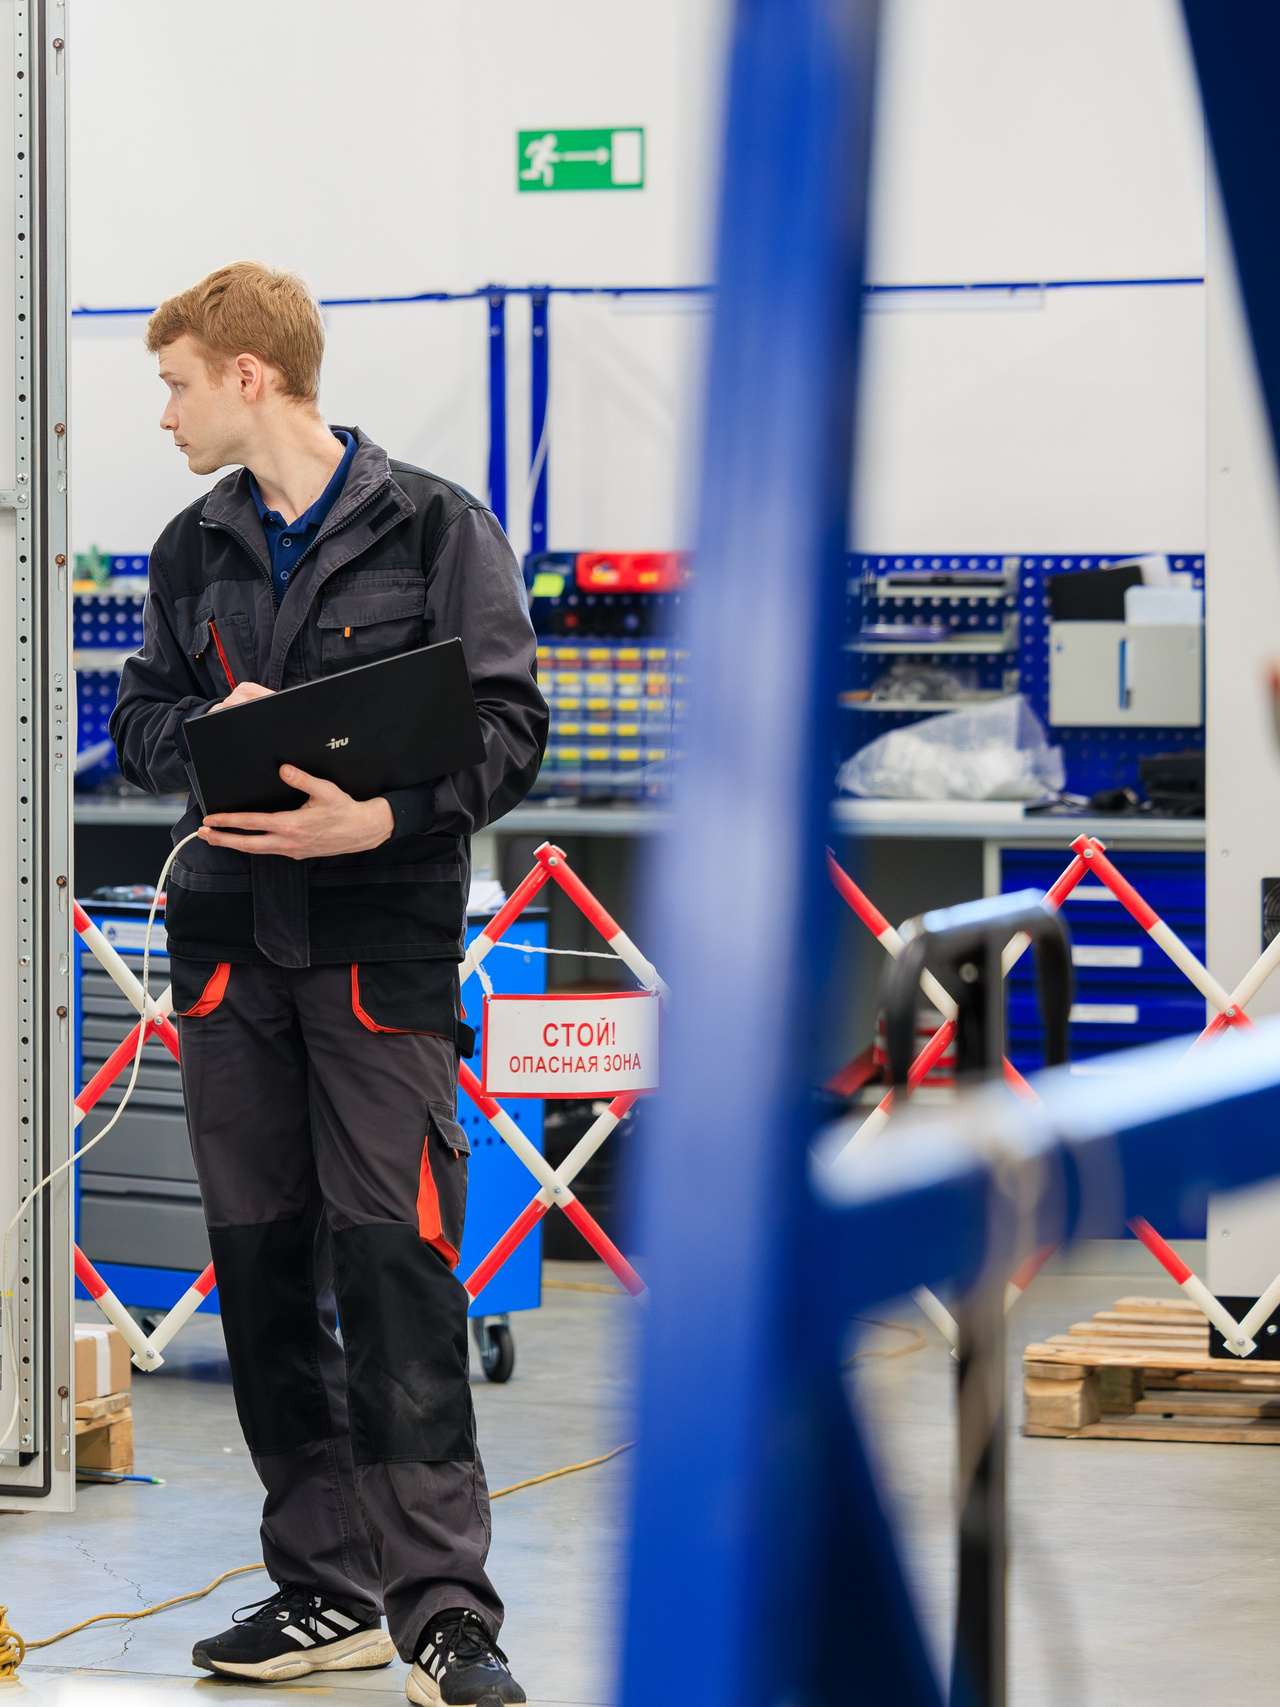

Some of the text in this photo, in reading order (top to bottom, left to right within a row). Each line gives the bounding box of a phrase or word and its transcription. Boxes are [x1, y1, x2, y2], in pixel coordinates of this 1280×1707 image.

[542, 1017, 616, 1047] СТОЙ!
[509, 1053, 642, 1074] ОПАСНАЯ ЗОНА
